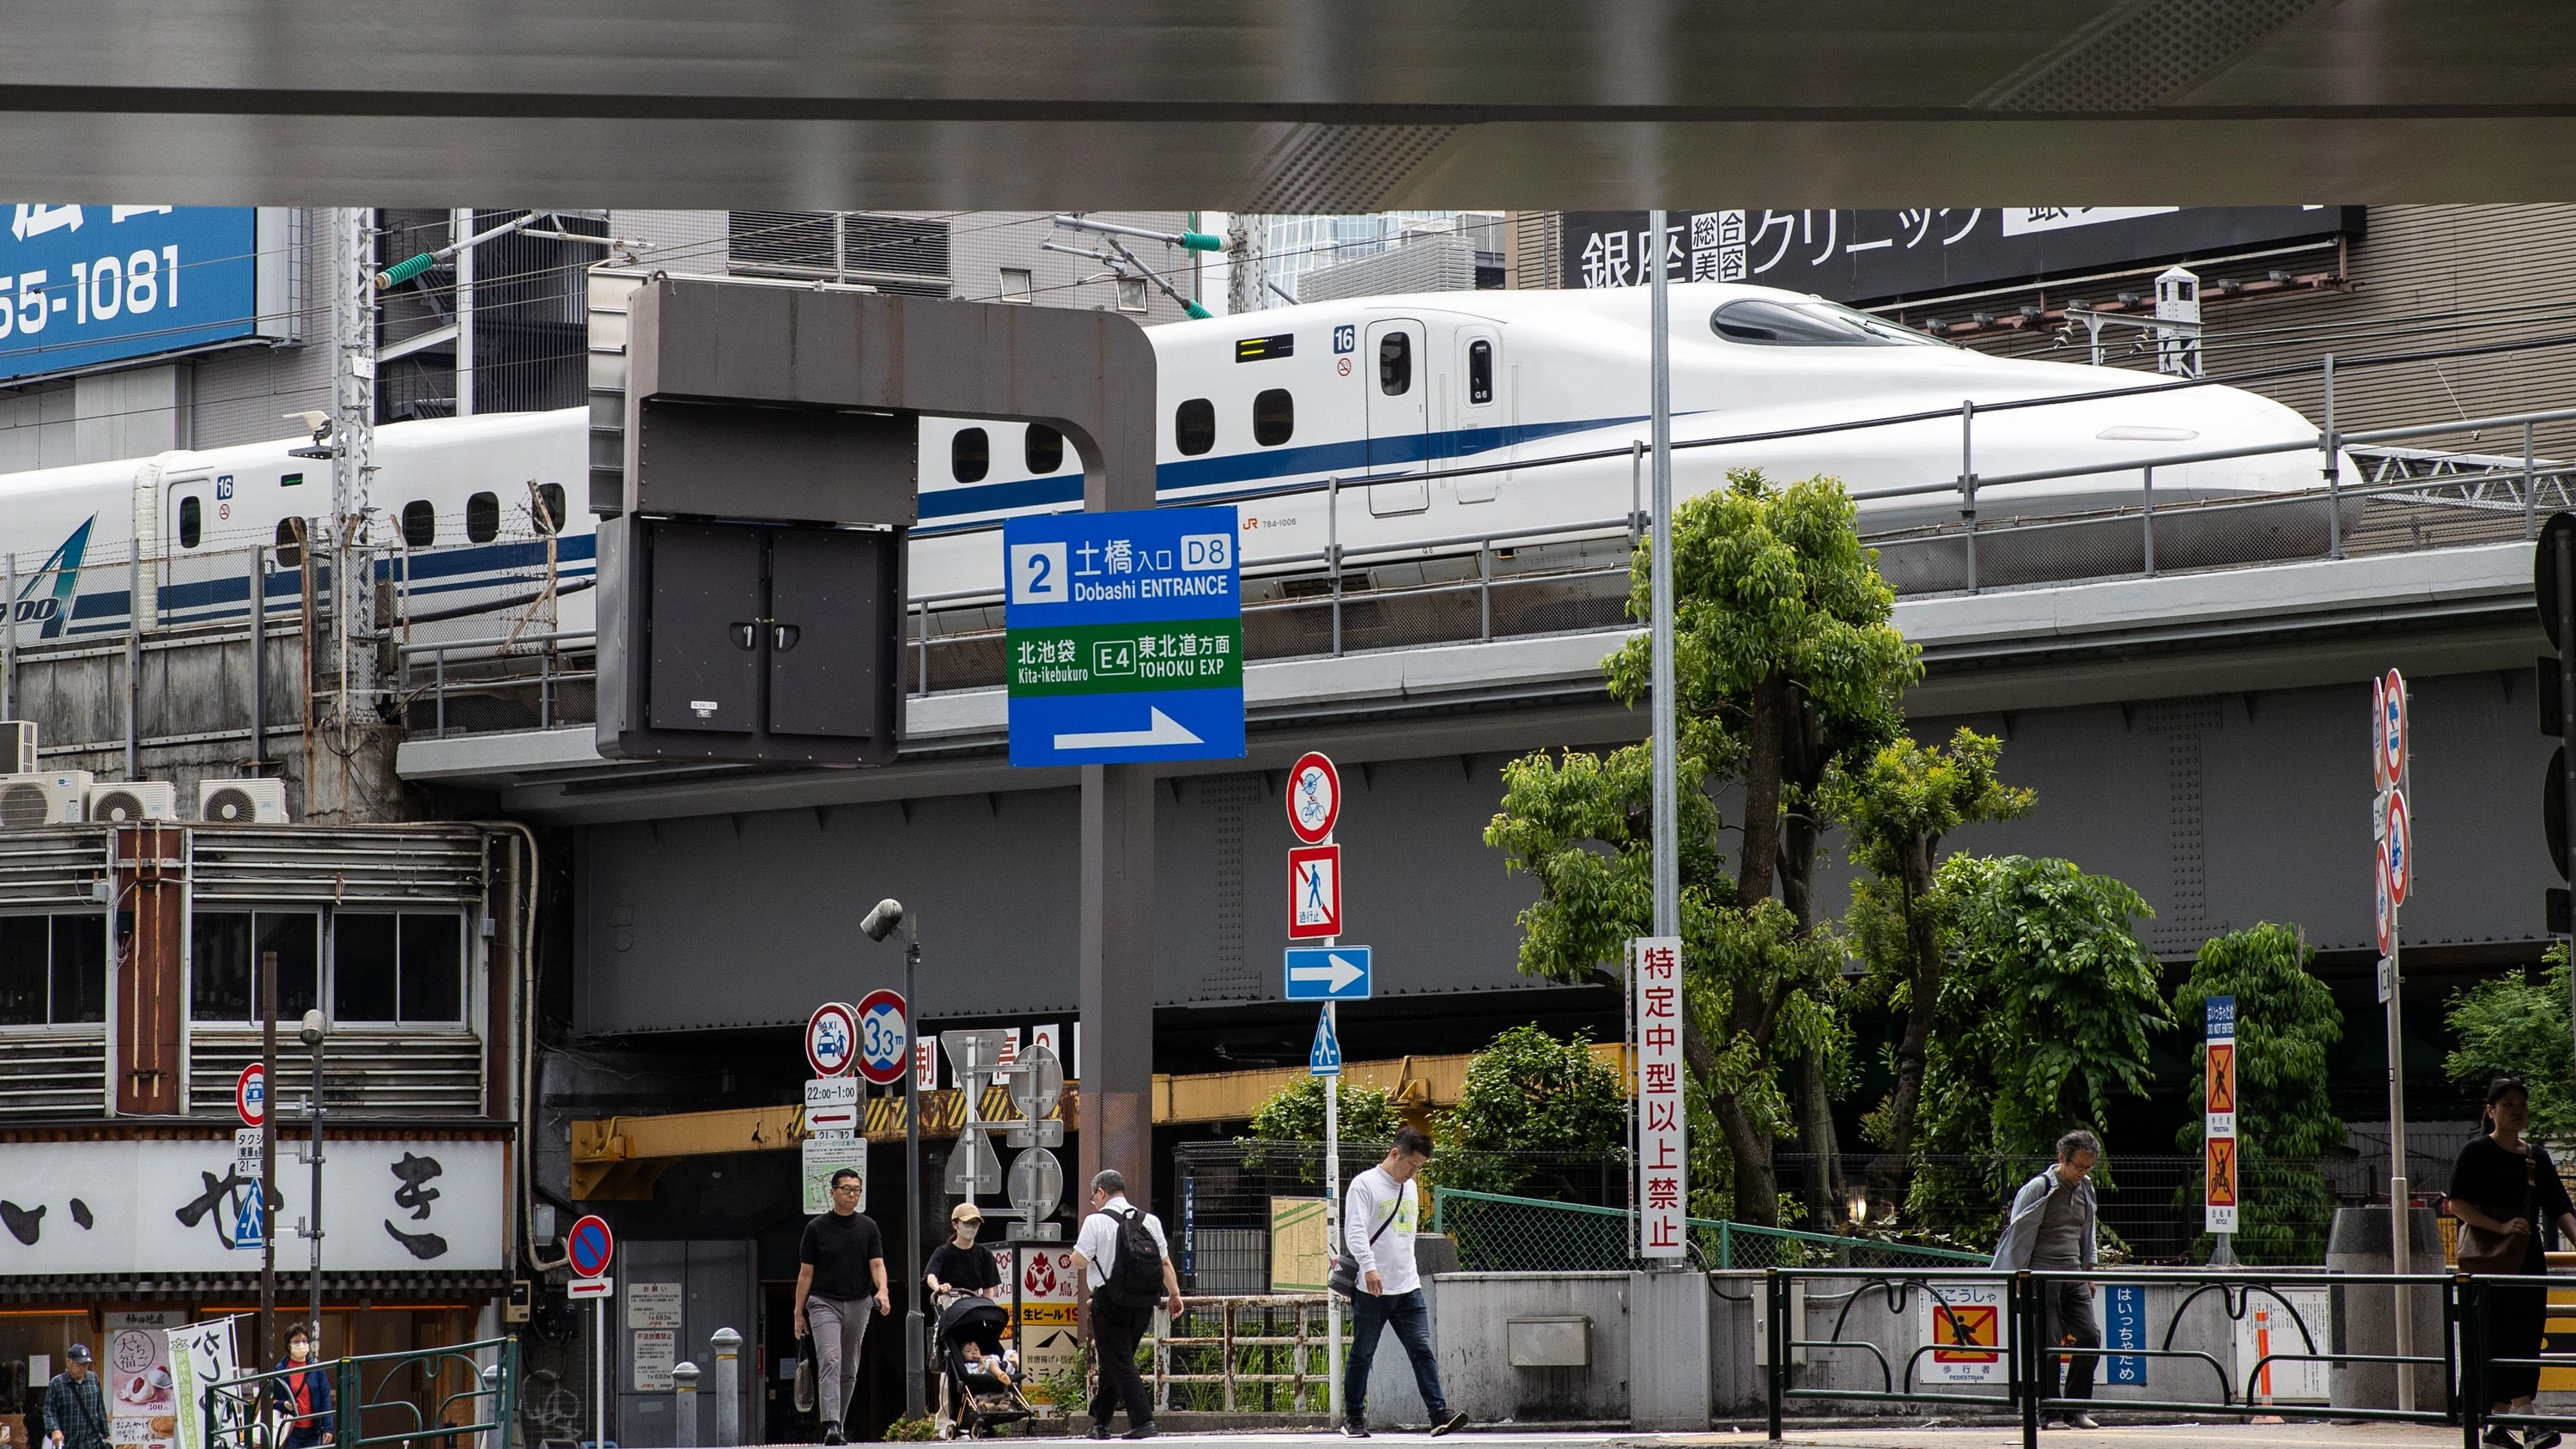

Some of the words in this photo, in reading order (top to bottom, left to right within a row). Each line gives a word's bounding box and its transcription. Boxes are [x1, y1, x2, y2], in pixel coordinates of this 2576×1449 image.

[1692, 212, 1743, 247] 総合
[1582, 225, 1686, 289] 銀座
[1694, 248, 1743, 283] 美容
[1335, 328, 1353, 350] 16
[218, 478, 232, 497] 16
[1243, 518, 1258, 530] JR
[1262, 518, 1297, 528] 784-1006
[1074, 539, 1172, 576] 土橋入口
[1188, 539, 1224, 565] D8
[1028, 553, 1052, 594] 2
[1074, 580, 1136, 602] Dobashi
[1140, 575, 1228, 599] ENTRANCE
[1018, 638, 1076, 665] 北池袋
[1100, 647, 1130, 669] E4
[1138, 633, 1230, 660] 東北道方面
[1018, 664, 1089, 685] Kita-ikebukuro
[1139, 660, 1194, 679] TOHOKU
[1200, 658, 1224, 676] EXP
[807, 1086, 855, 1100] 22:00-1:00
[1643, 946, 1680, 1248] 特定中型以上禁止
[1024, 1308, 1064, 1321] 生ビール
[1942, 1365, 1990, 1374] 歩行者
